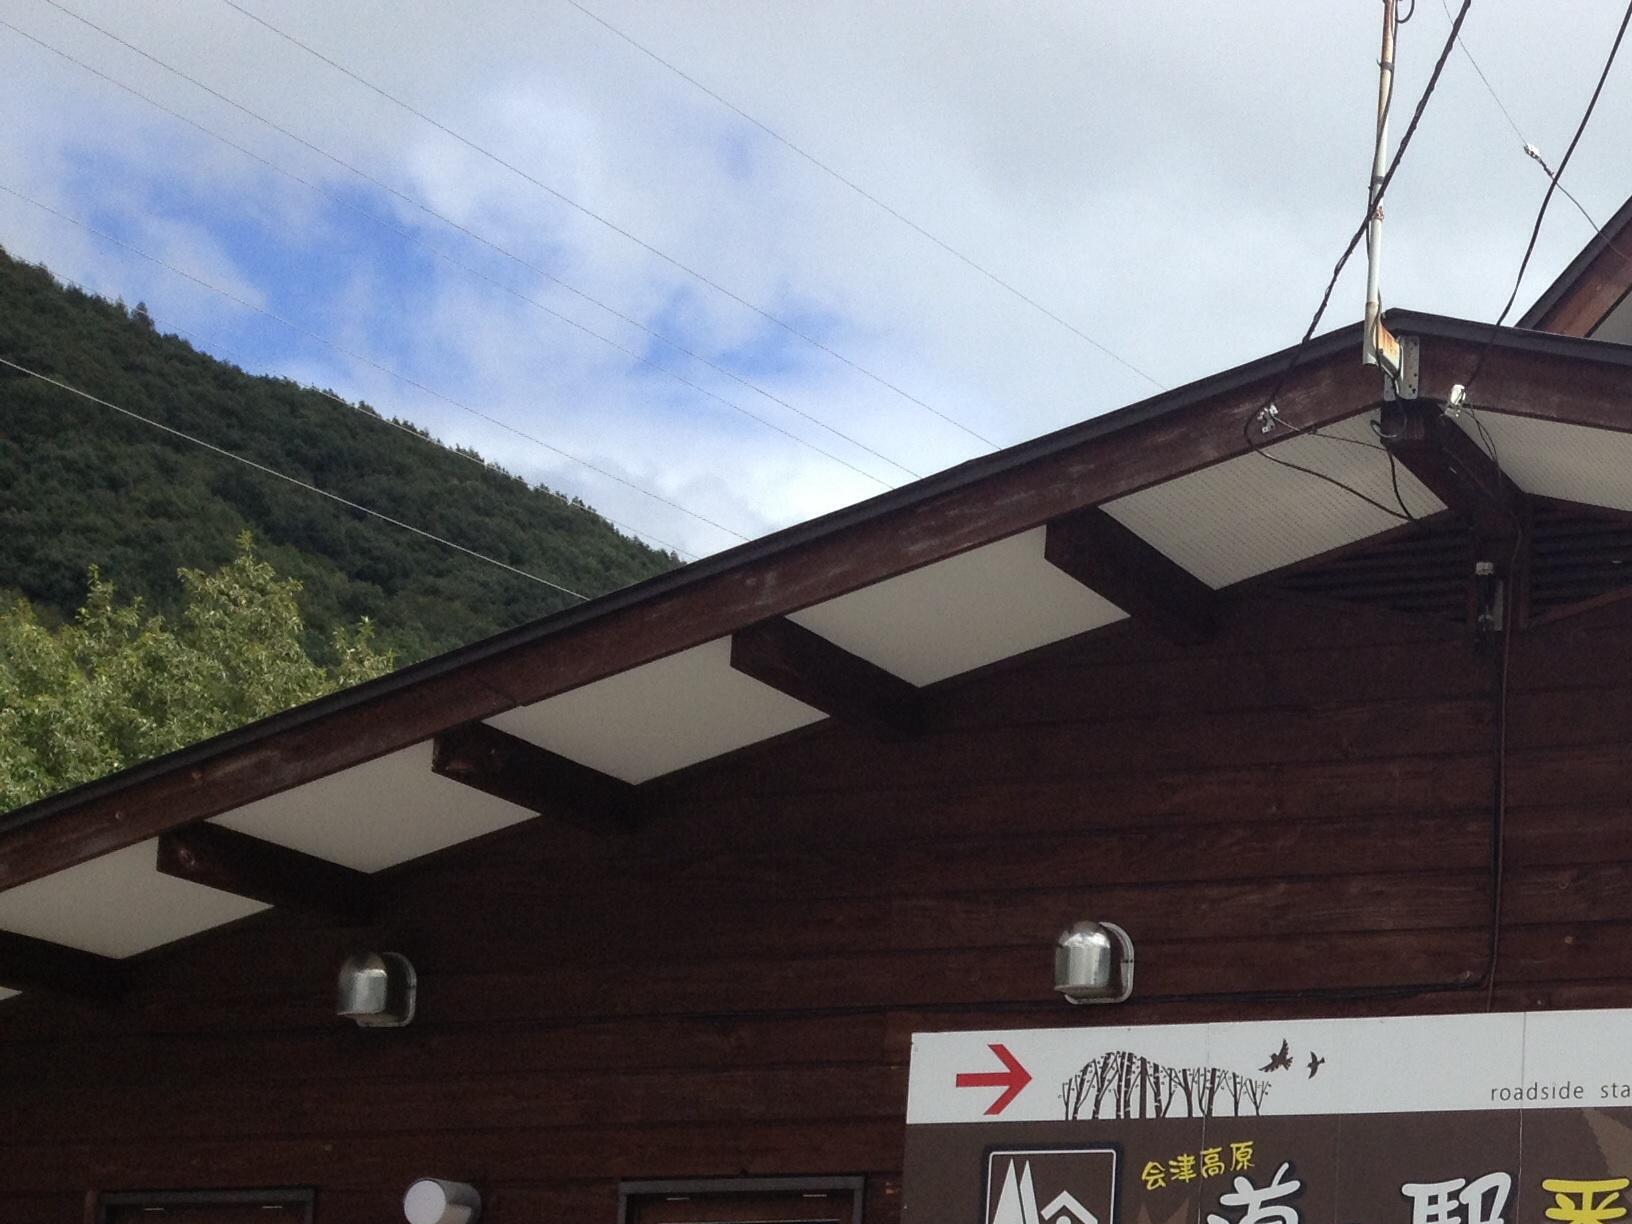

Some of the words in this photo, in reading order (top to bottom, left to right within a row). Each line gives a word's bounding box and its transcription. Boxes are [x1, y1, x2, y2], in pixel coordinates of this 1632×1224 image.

[1491, 1081, 1584, 1101] roadside
[1140, 1139, 1256, 1191] 会津高原
